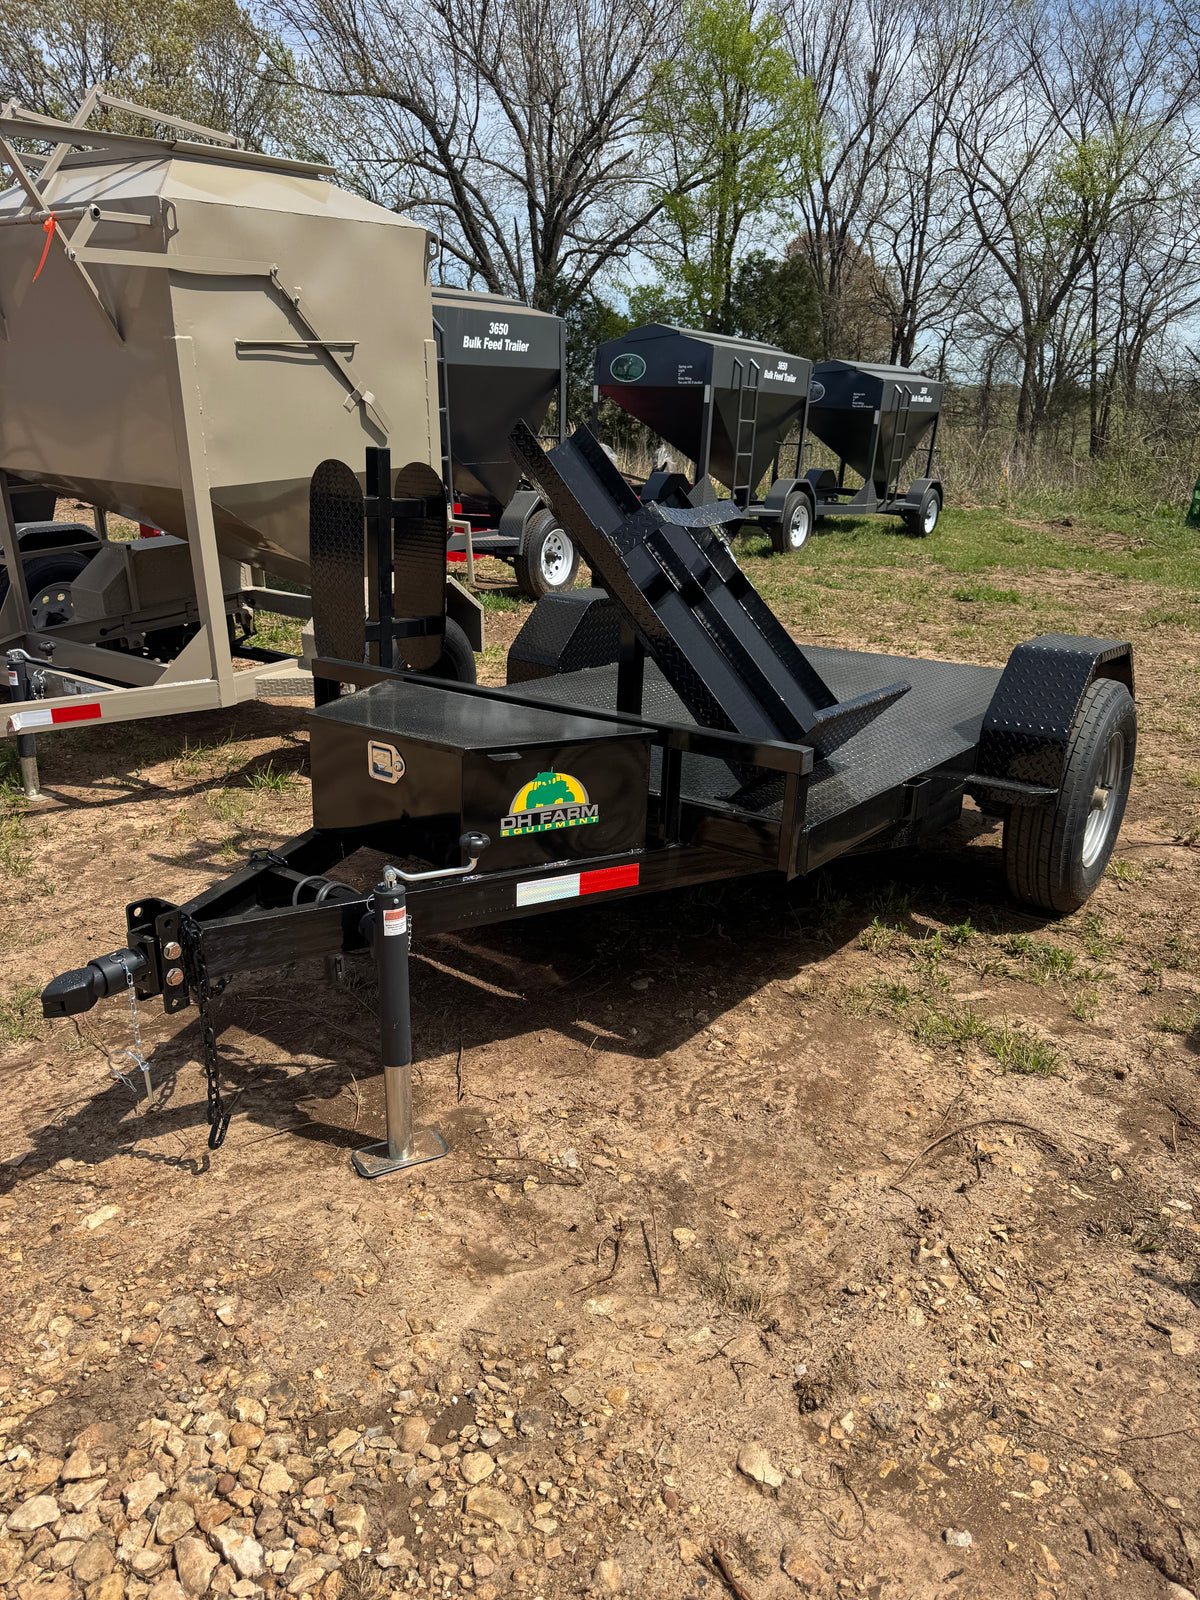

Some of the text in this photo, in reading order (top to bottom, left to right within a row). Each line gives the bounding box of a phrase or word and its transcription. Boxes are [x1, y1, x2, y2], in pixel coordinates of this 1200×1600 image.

[489, 322, 509, 335] 3650
[462, 336, 529, 352] Bulk Feed Trailer
[500, 804, 599, 830] DH FARM
[501, 815, 599, 837] EQUIPMENT
